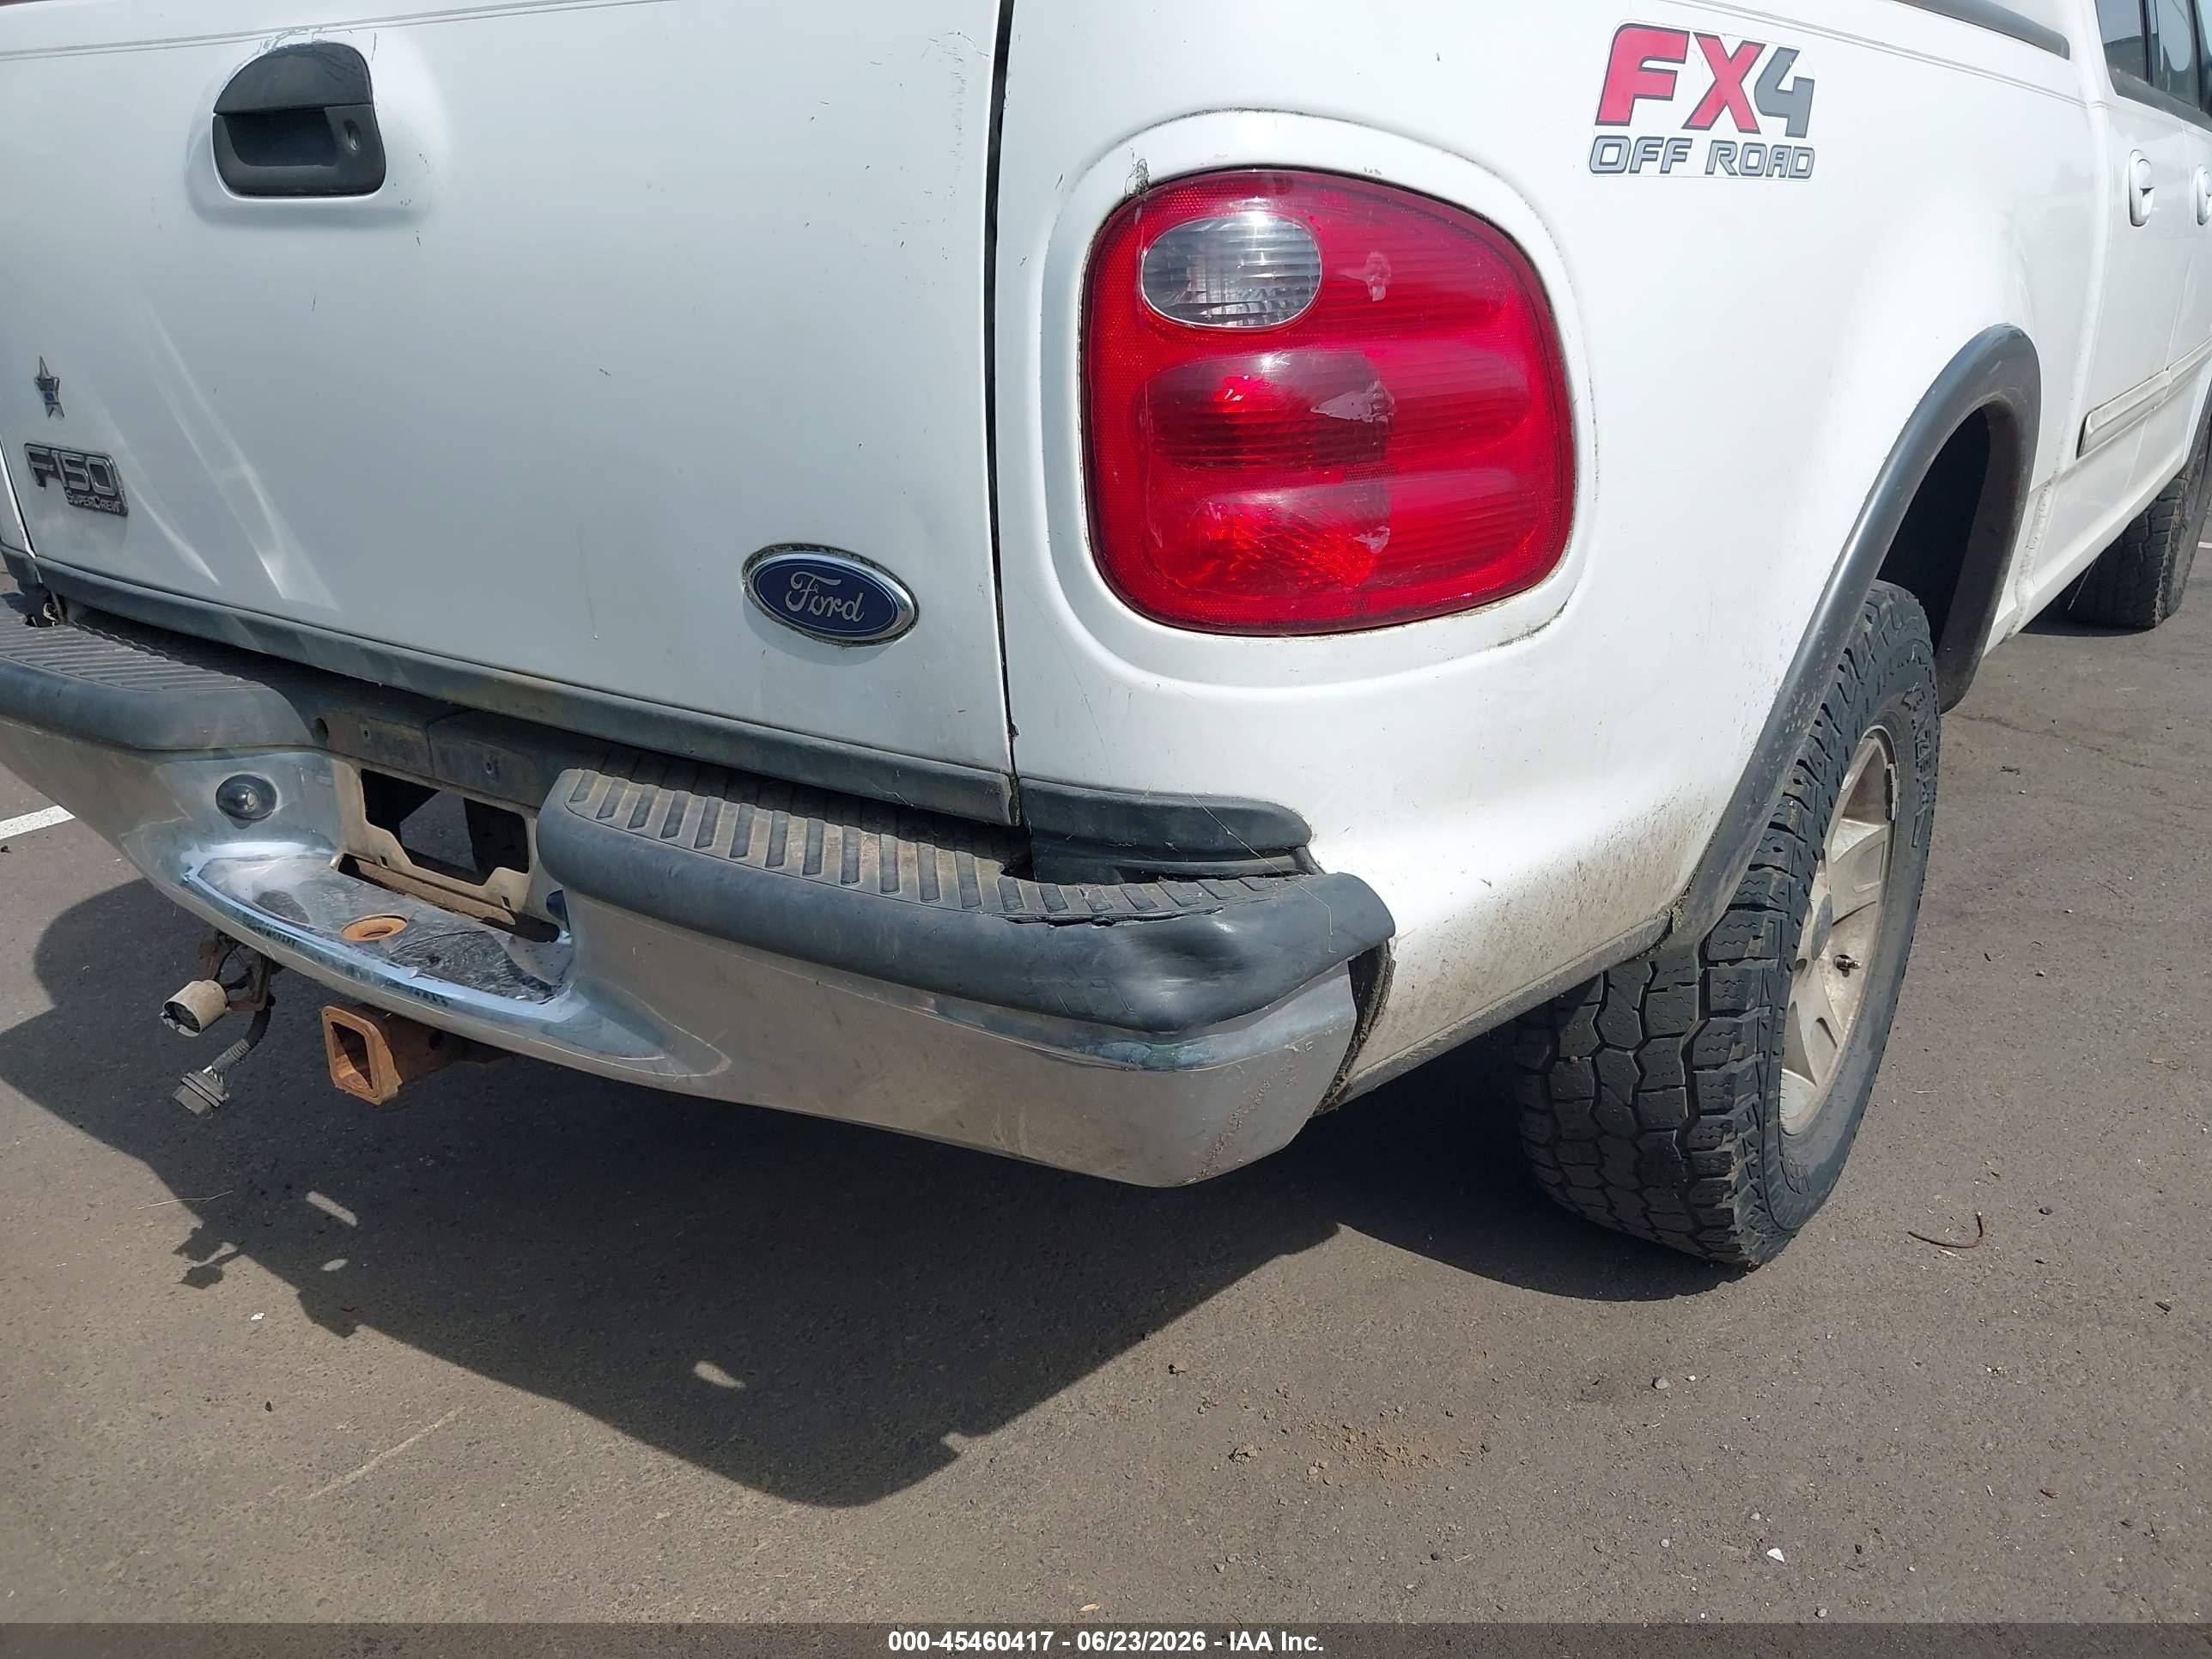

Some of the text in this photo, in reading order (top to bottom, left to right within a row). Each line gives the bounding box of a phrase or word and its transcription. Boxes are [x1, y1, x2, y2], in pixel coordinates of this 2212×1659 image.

[1595, 23, 1815, 138] FX4
[1589, 135, 1815, 179] OFF ROAD
[785, 571, 865, 623] Ford
